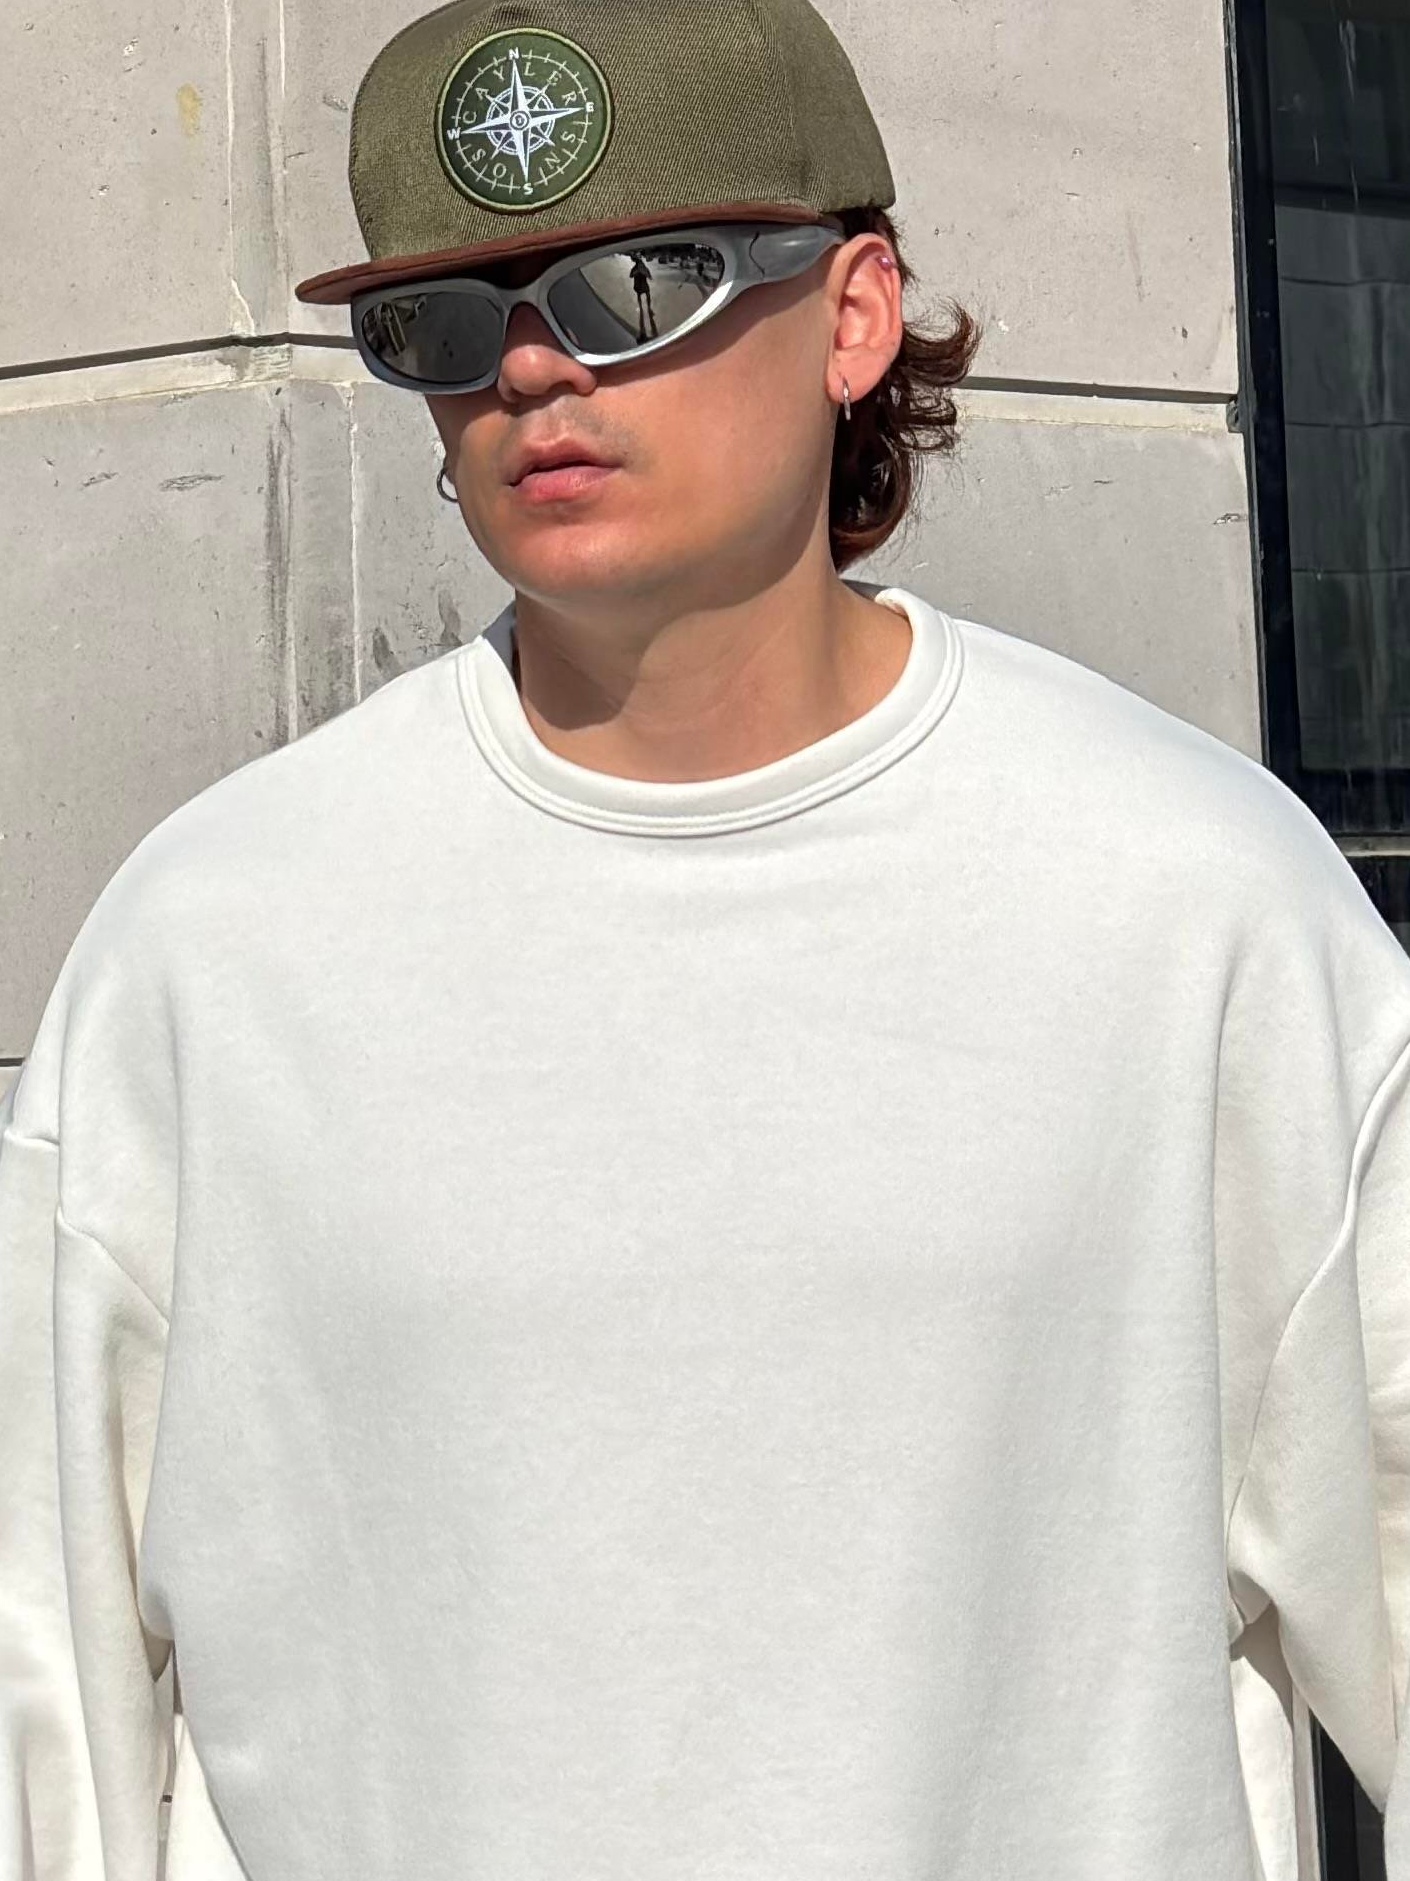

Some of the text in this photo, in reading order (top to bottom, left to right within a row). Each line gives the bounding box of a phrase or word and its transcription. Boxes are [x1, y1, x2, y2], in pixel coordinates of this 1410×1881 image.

[508, 46, 520, 60] N
[462, 61, 578, 125] CAYLER
[446, 126, 462, 141] W
[523, 182, 534, 196] S
